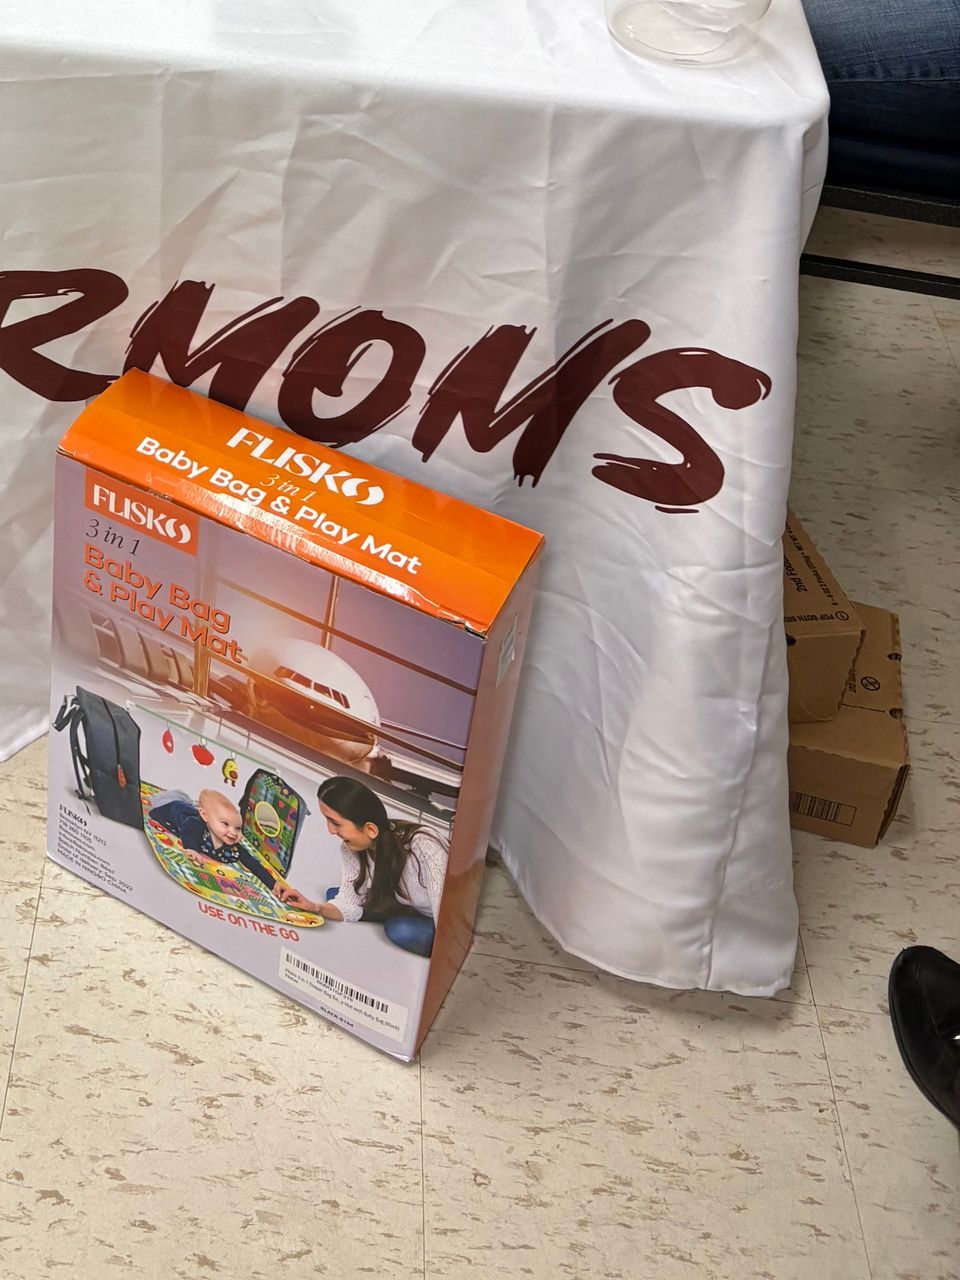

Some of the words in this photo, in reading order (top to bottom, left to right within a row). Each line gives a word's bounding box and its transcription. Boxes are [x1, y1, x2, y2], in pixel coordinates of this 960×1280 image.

[226, 427, 385, 506] FLISKO
[259, 473, 275, 487] 3
[279, 480, 301, 497] in
[301, 490, 317, 503] 1
[93, 484, 191, 544] FLISKO
[136, 436, 210, 479] Baby
[209, 468, 267, 507] Bag
[270, 496, 291, 515] &
[296, 506, 360, 545] Play
[360, 535, 423, 575] Mat
[85, 518, 100, 538] 3
[103, 526, 125, 549] in
[130, 538, 141, 557] 1
[83, 570, 104, 596] &
[110, 581, 175, 632] Play
[180, 615, 243, 664] Mat
[84, 543, 163, 600] Baby
[168, 582, 231, 635] Bag
[57, 848, 74, 863] MADE
[74, 859, 81, 868] IN
[107, 879, 128, 894] CHINA
[198, 901, 226, 921] USE
[248, 919, 278, 937] THE
[279, 927, 300, 942] GO
